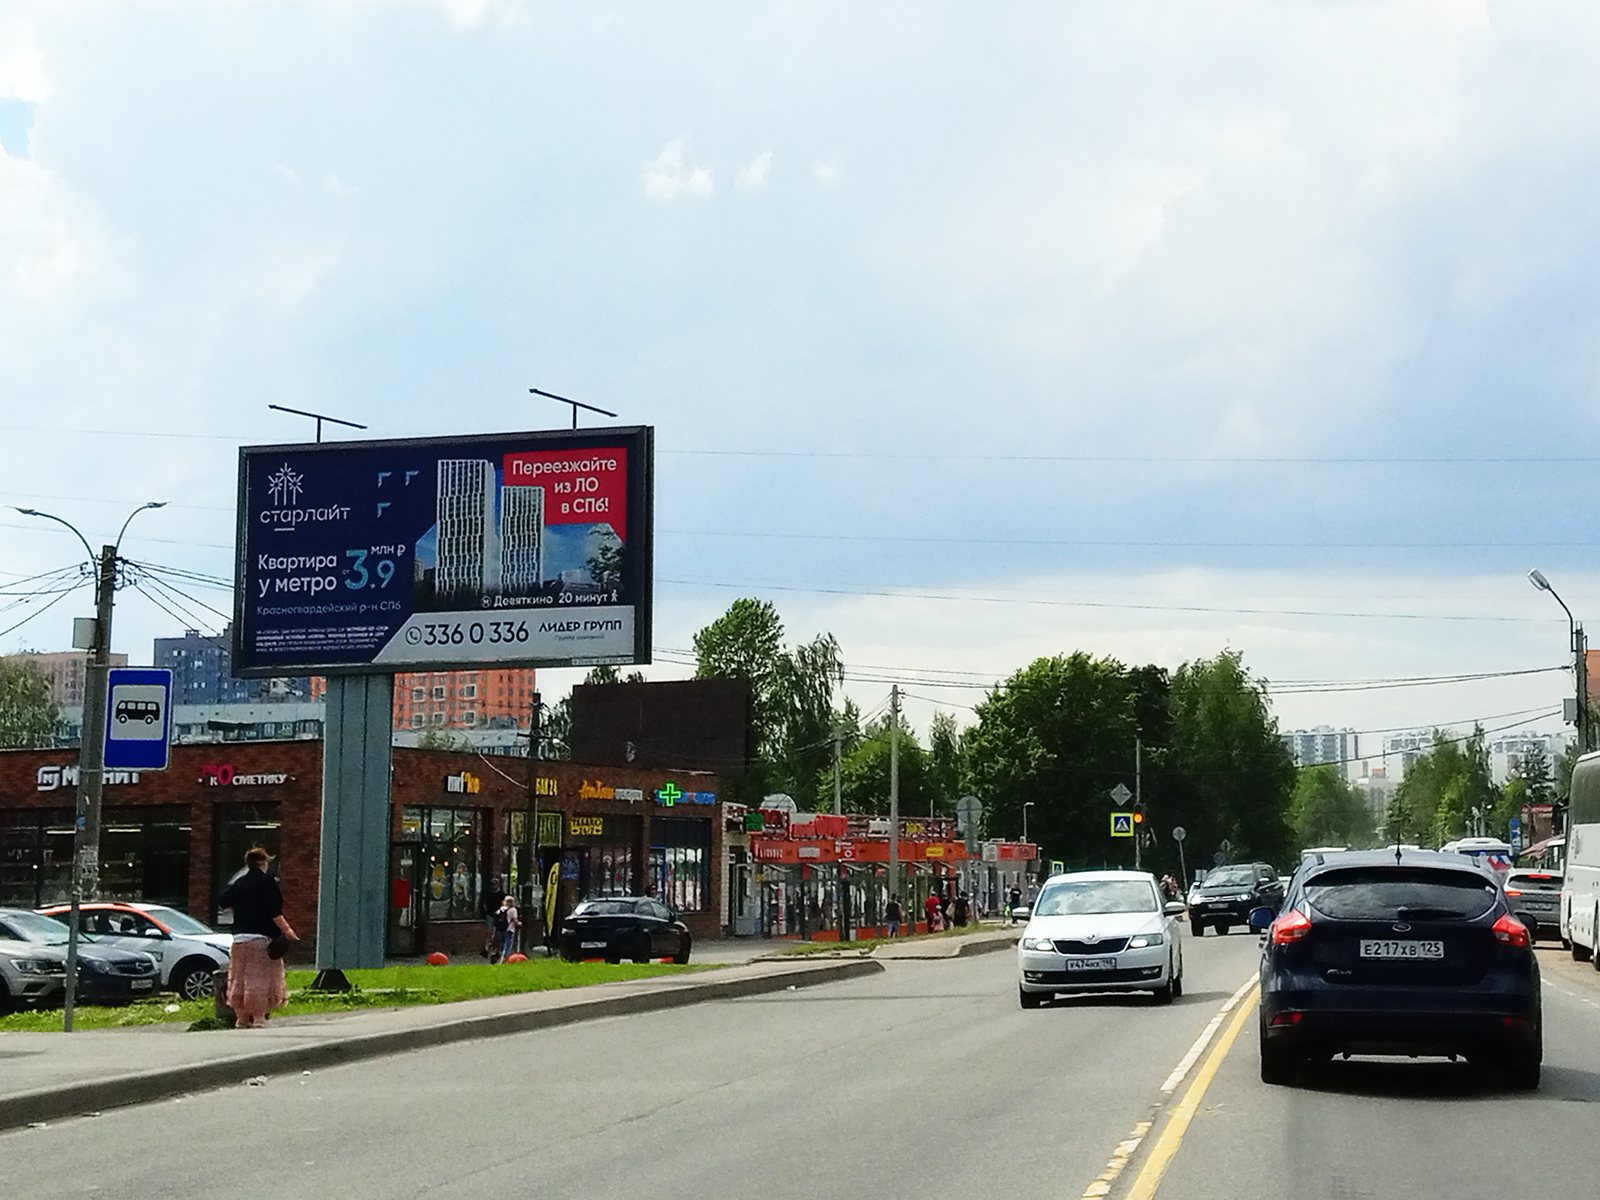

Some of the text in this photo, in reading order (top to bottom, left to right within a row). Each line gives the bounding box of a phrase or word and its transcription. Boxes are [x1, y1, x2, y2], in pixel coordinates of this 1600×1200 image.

[512, 457, 617, 478] Переезжайте
[554, 477, 599, 494] из ЛО
[561, 497, 609, 514] в СПб!
[259, 504, 351, 527] старлайт
[371, 545, 394, 555] млн
[258, 554, 337, 573] Квартира
[258, 576, 337, 598] у метро
[493, 593, 608, 608] Девяткино 20 минут
[424, 621, 529, 646] 336 0 336
[539, 620, 622, 633] ЛИДЕР ГРУПП
[1364, 942, 1441, 956] Е217ХВ 125
